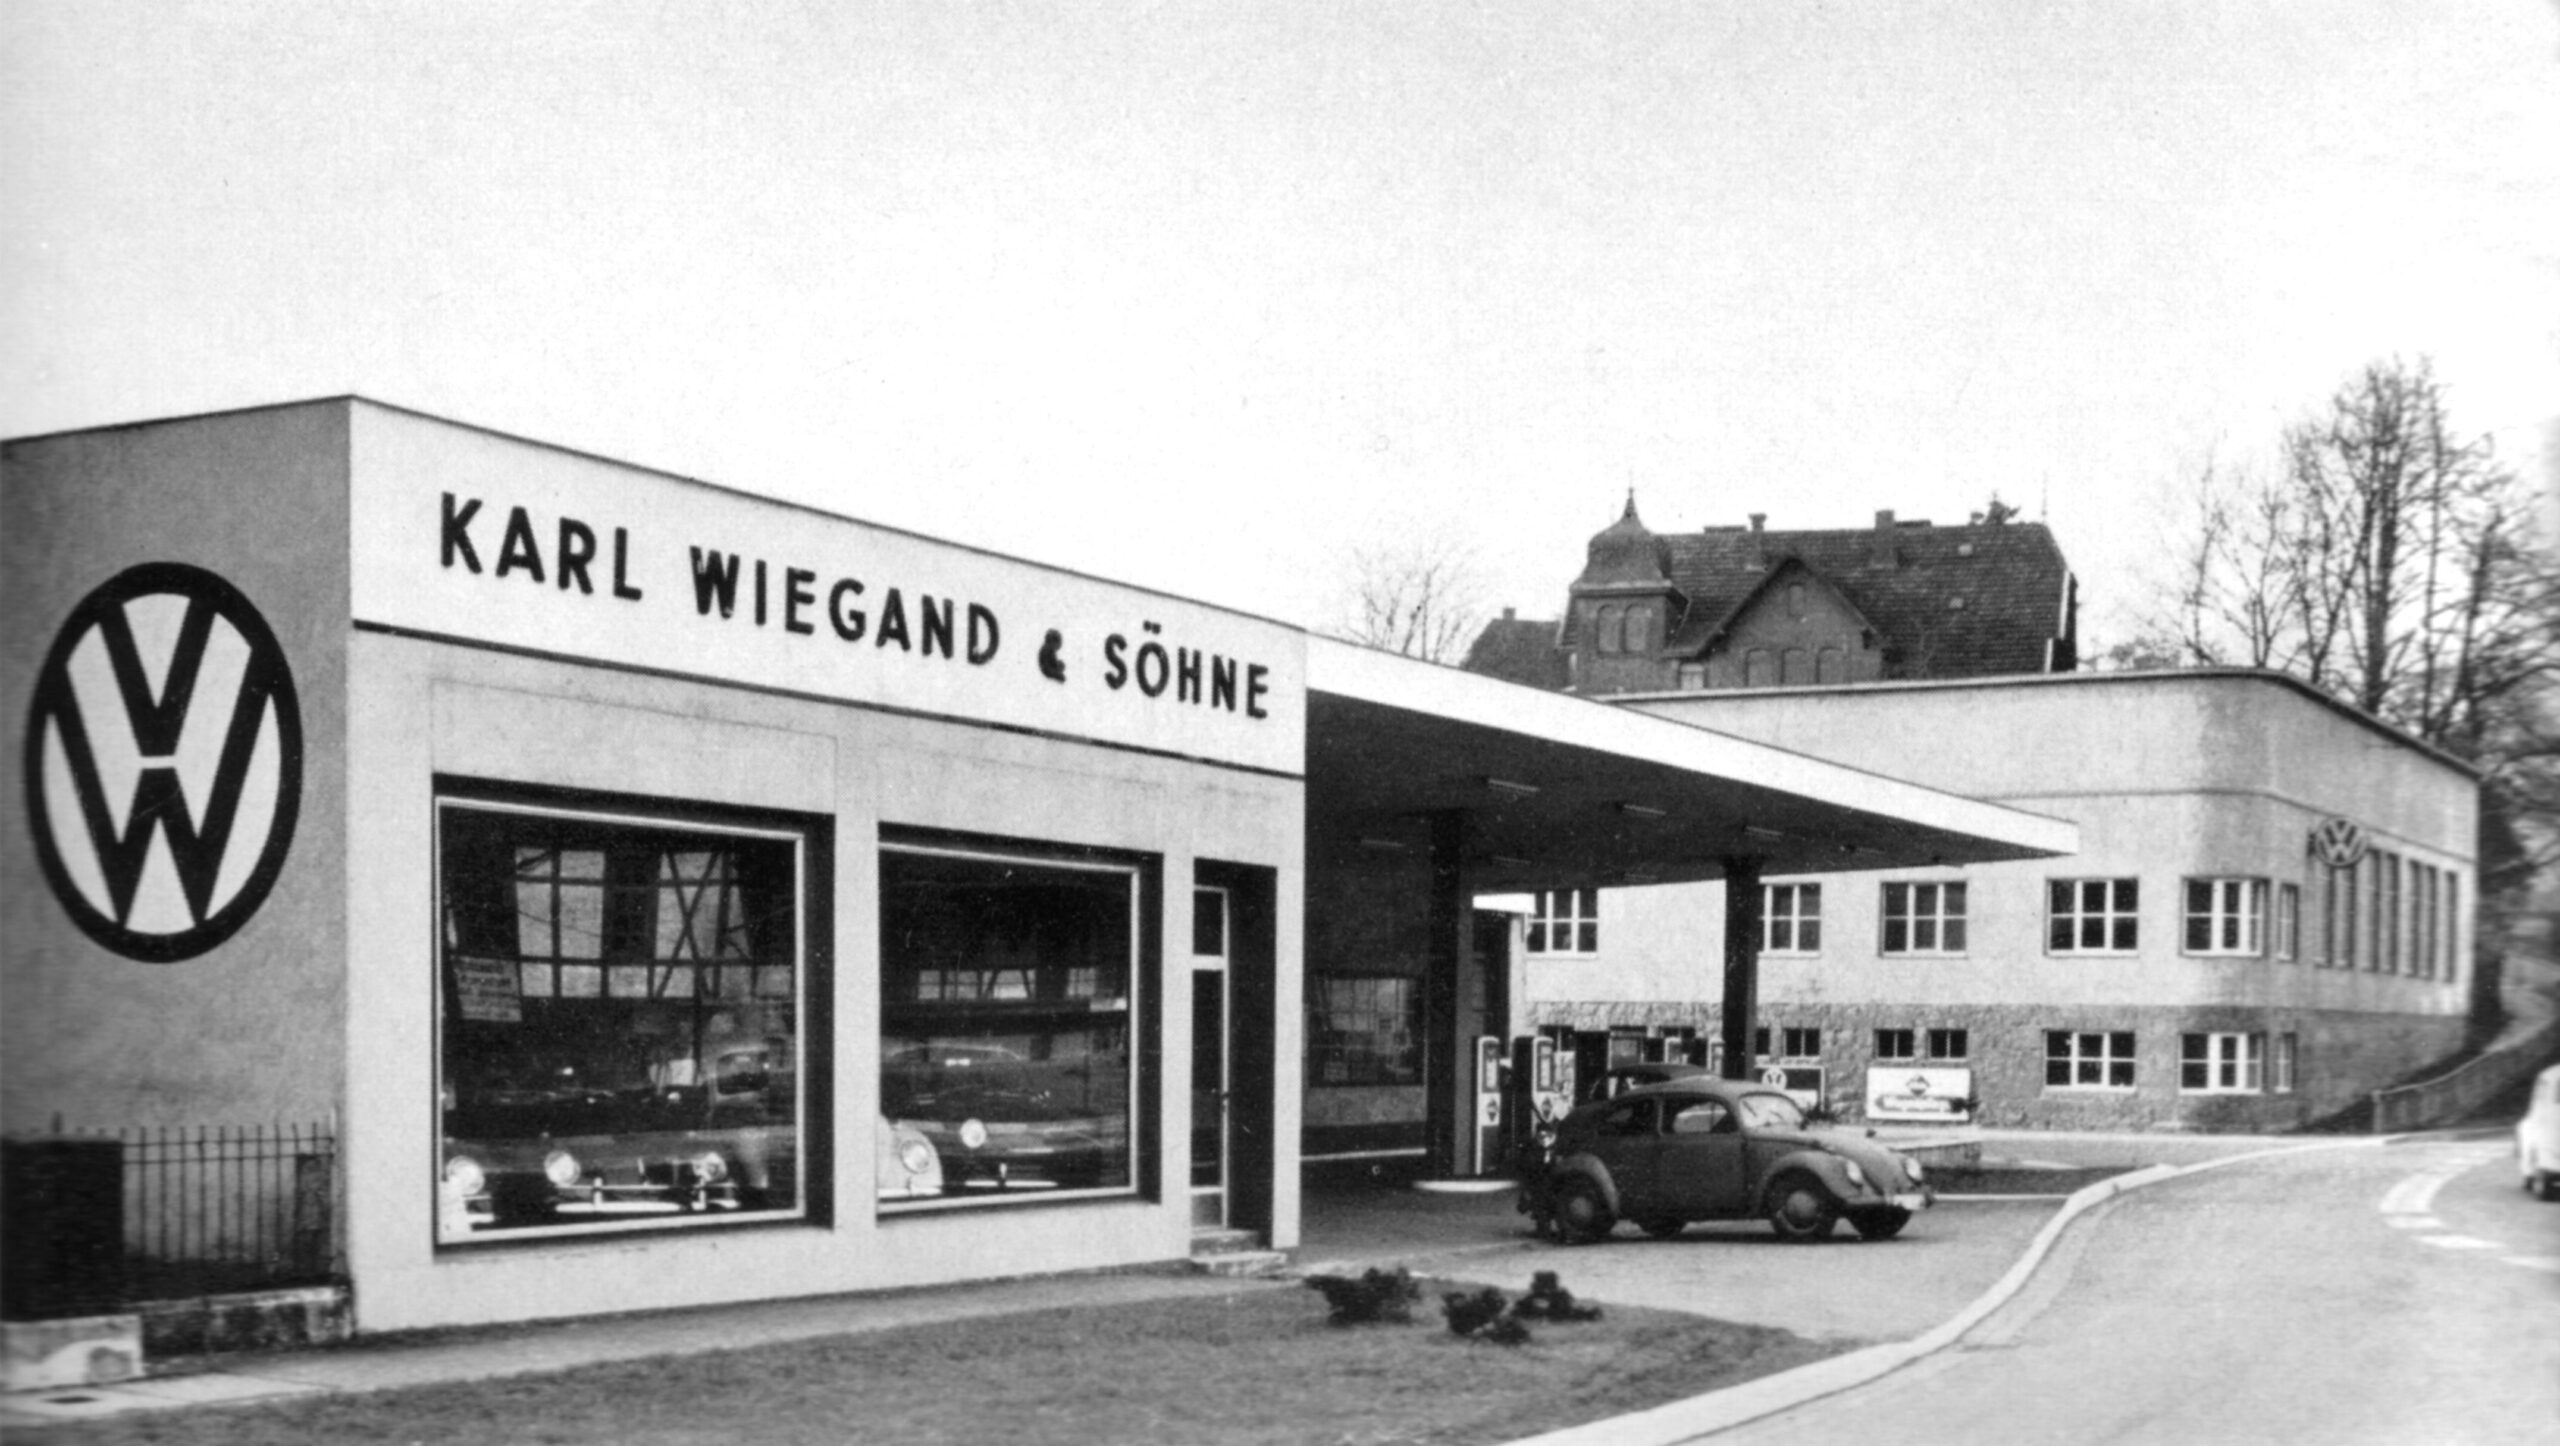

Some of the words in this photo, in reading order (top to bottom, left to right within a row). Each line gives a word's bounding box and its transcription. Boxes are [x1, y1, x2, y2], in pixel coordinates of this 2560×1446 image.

[440, 491, 644, 602] KARL
[689, 545, 1000, 666] WIEGAND
[1037, 628, 1067, 683] &
[1103, 620, 1269, 720] SÖHNE
[30, 570, 295, 952] VW
